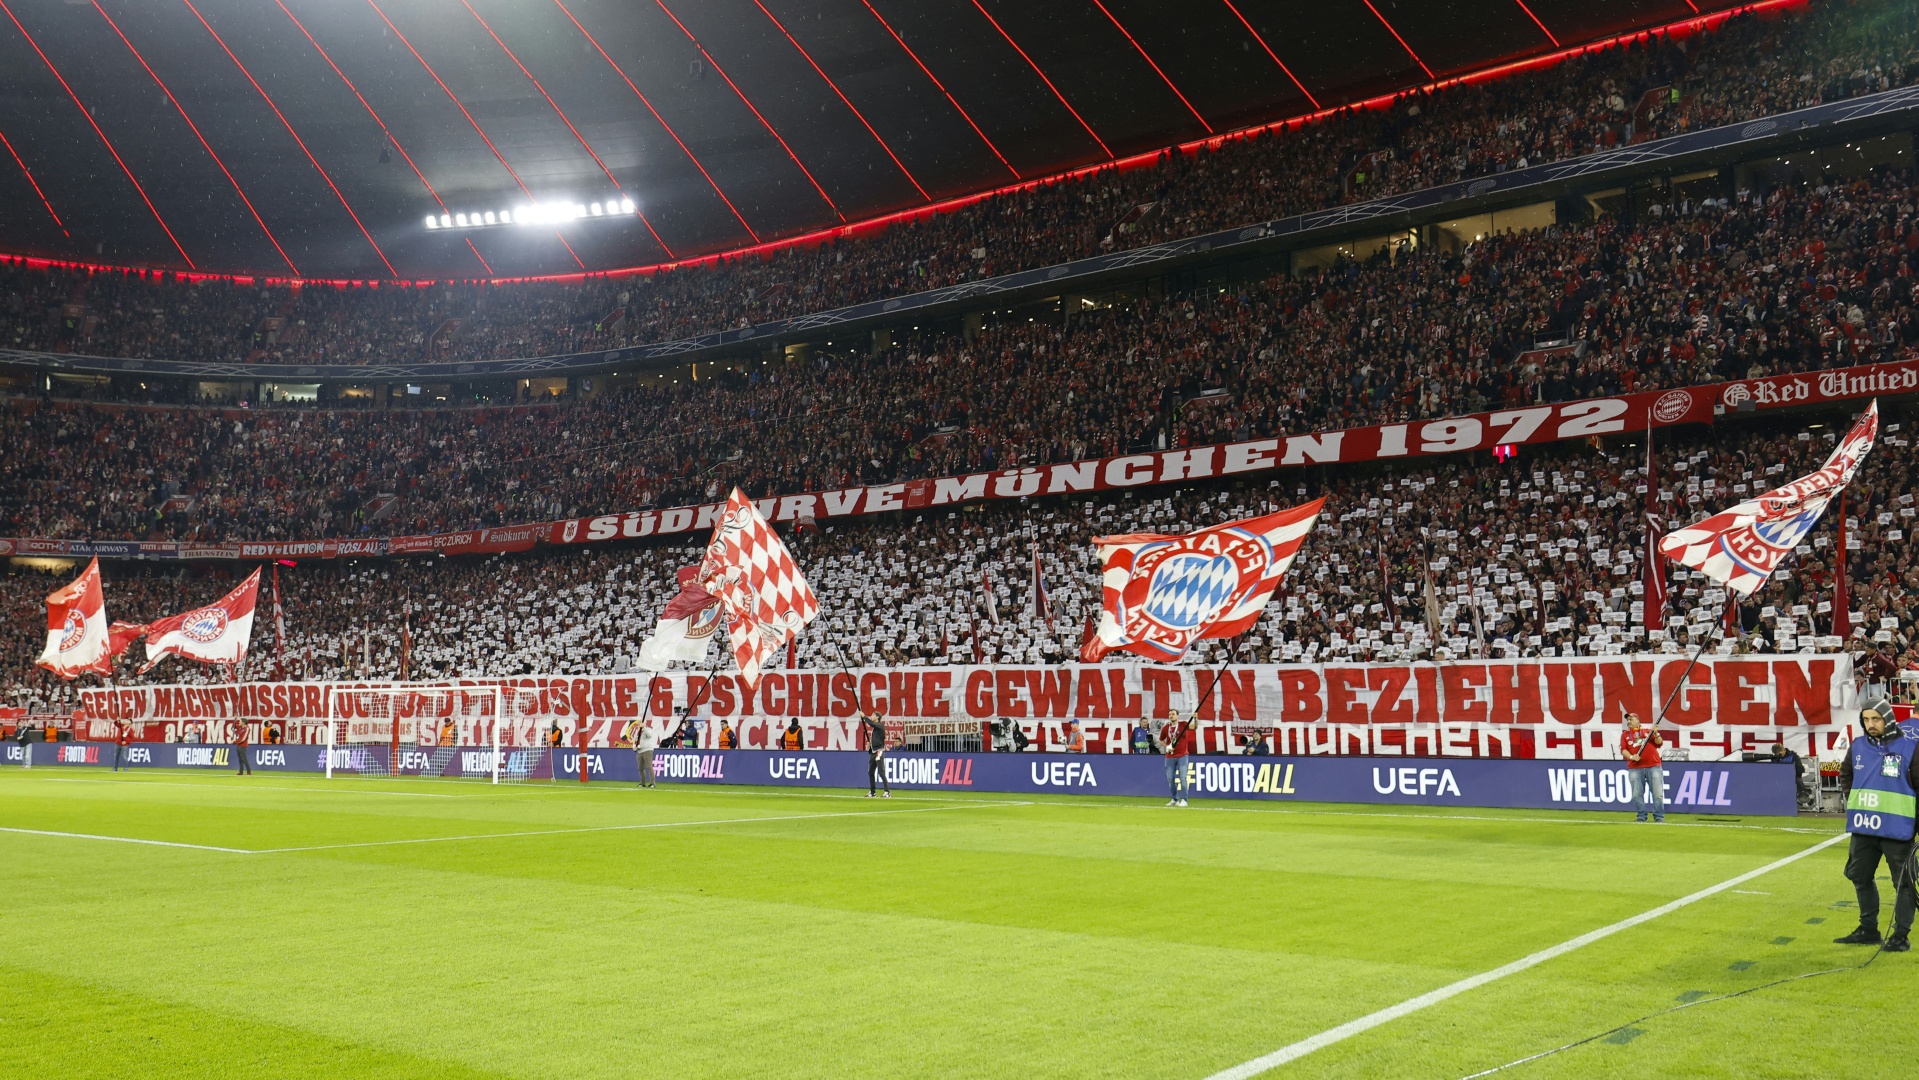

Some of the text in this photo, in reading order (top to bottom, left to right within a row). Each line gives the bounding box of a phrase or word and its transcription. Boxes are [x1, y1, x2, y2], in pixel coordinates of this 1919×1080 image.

[1753, 378, 1809, 403] Red
[1818, 365, 1918, 397] United
[931, 431, 1346, 504] MÜNCHEN
[1376, 398, 1629, 457] 1972
[434, 533, 473, 548] BFC ZÜRICH
[490, 529, 531, 543] Südkurve
[94, 545, 129, 553] AIRWAYS
[82, 689, 147, 719] GEGEN
[153, 684, 391, 718] MACHTMISSBRAUCH
[400, 682, 454, 718] UND
[650, 676, 673, 717] &
[686, 671, 952, 719] PSYCHISCHE
[965, 667, 1183, 719] GEWALT
[1194, 669, 1257, 722] IN
[1277, 659, 1835, 726] BEZIEHUNGEN
[372, 722, 412, 736] MUNIHS
[905, 724, 937, 736] IMMER
[940, 723, 955, 734] BEI
[958, 721, 978, 733] UNS
[57, 745, 100, 763] #FOOTBALL
[177, 747, 230, 766] WELCOME ALL
[256, 749, 286, 766] UEFA
[317, 749, 367, 769] #OOTBALL
[398, 751, 430, 770] UEFA
[461, 751, 528, 773] WELCOE ALL
[652, 754, 724, 779] #FOOTBALL
[769, 757, 821, 780] UEFA
[940, 758, 974, 785] ALL
[1031, 761, 1098, 787] UEFA
[1372, 766, 1462, 797] UEFA
[1674, 770, 1732, 806] ALL
[1858, 792, 1879, 808] HB
[1853, 813, 1882, 830] 040
